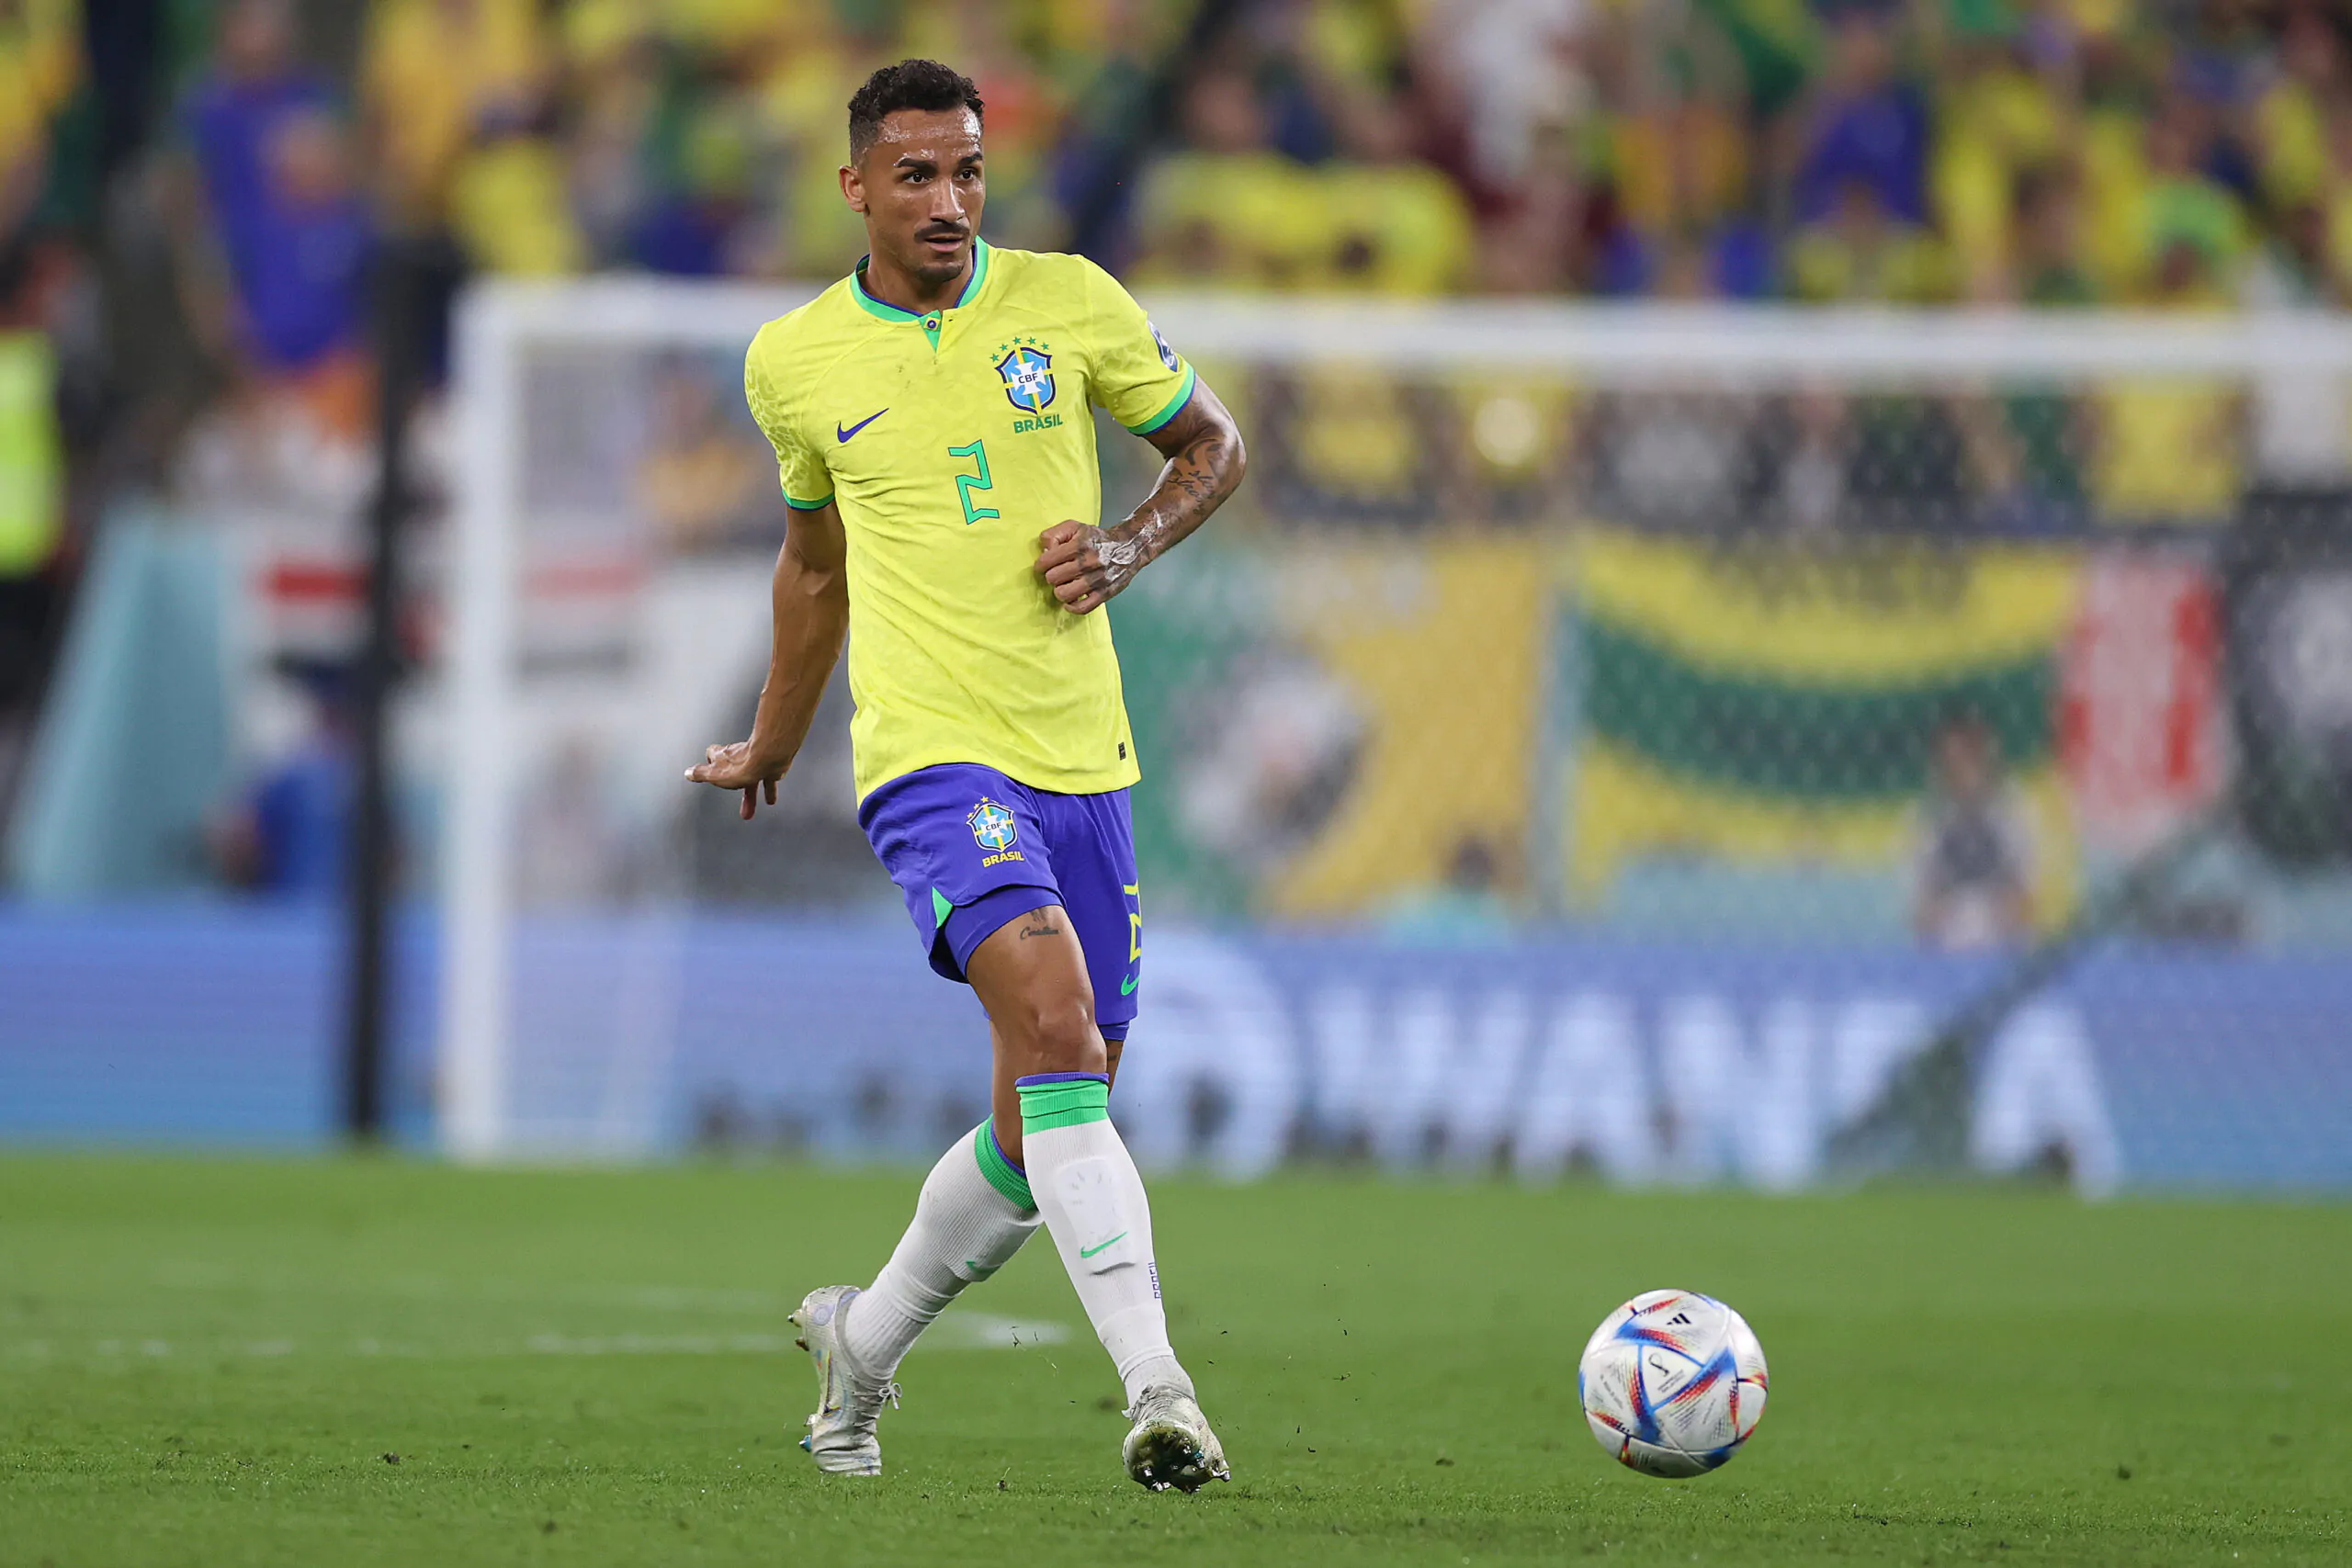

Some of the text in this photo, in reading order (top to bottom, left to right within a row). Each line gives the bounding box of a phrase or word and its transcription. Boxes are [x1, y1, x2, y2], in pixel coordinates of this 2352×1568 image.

[1018, 372, 1038, 384] CBF
[1013, 413, 1063, 434] BRASIL
[947, 438, 1001, 525] 2
[985, 821, 1001, 831] CBF
[981, 851, 1025, 868] BRASIL
